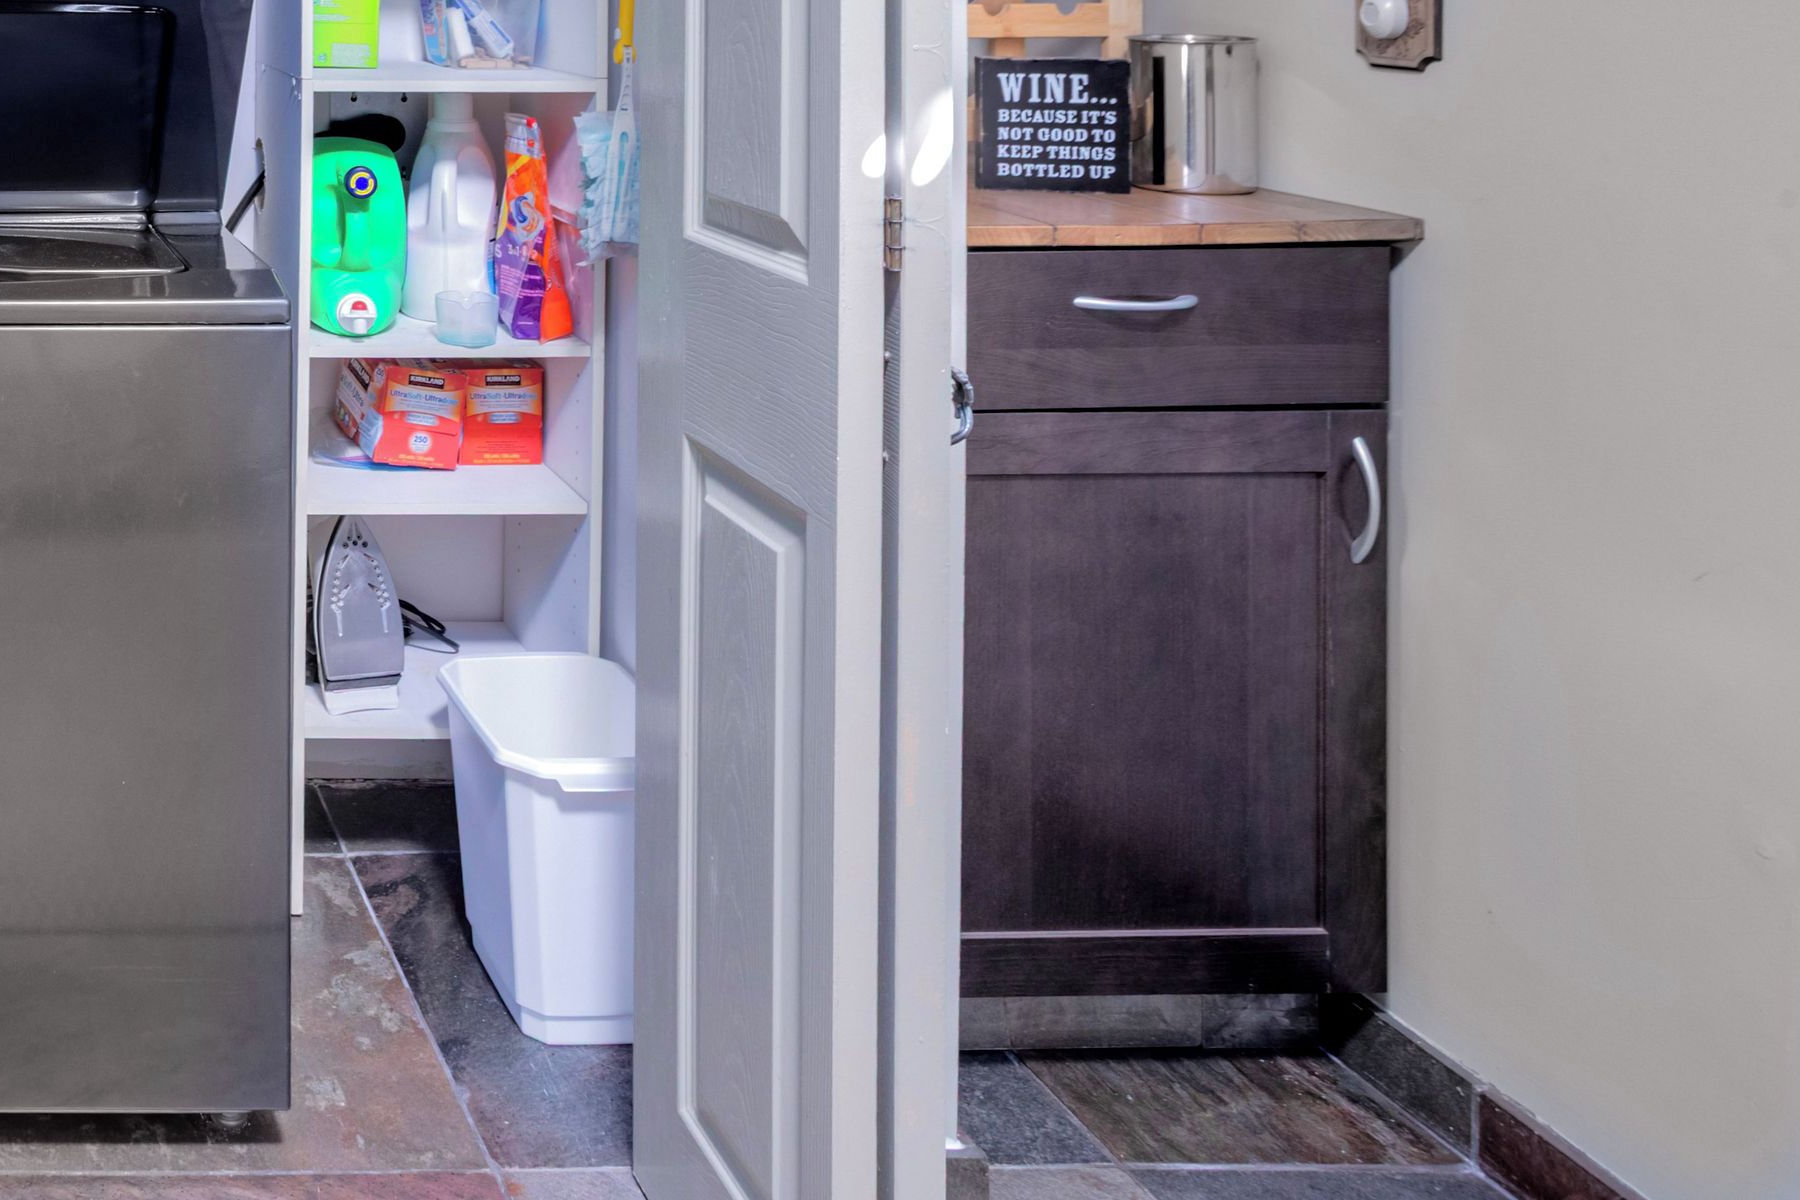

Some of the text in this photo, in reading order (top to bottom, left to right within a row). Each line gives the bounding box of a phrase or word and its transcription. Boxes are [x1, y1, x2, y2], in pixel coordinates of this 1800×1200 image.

[997, 73, 1118, 104] WINE...
[997, 109, 1117, 124] BECAUSE IT'S
[997, 127, 1116, 143] NOT GOOD TO
[997, 145, 1116, 161] KEEP THINGS
[997, 163, 1116, 179] BOTTLED UP
[410, 376, 444, 385] KIRKLAND
